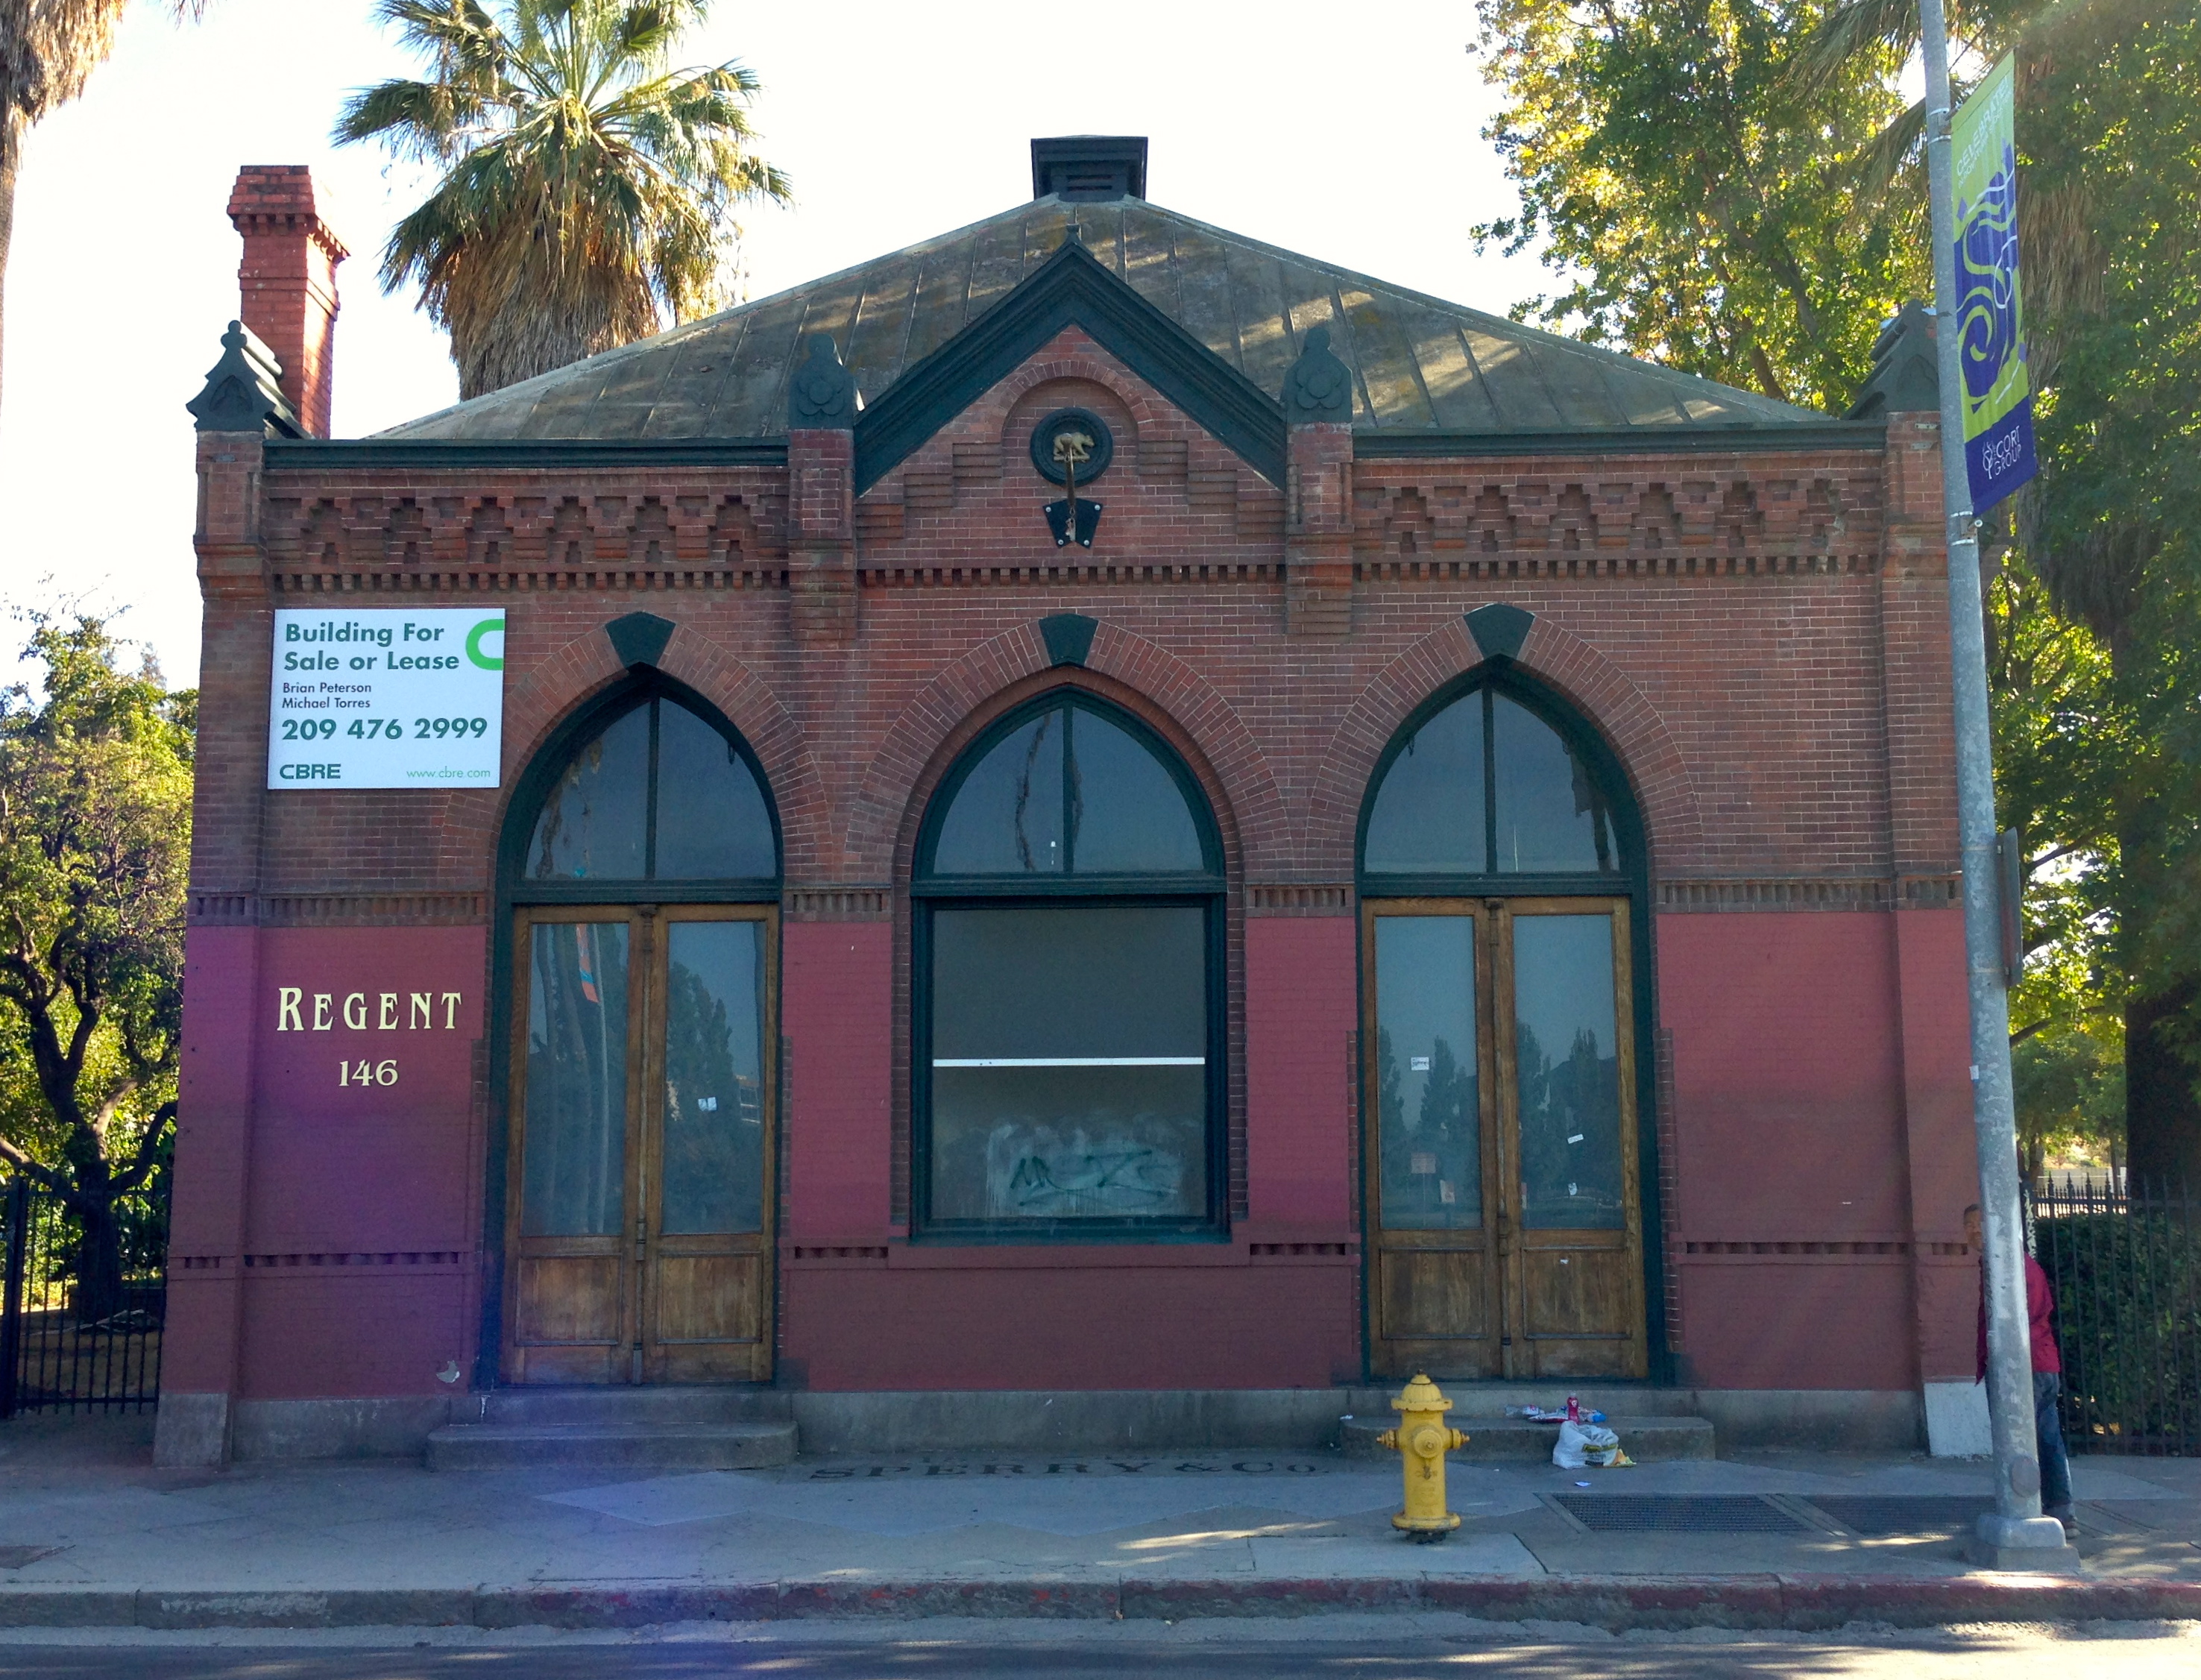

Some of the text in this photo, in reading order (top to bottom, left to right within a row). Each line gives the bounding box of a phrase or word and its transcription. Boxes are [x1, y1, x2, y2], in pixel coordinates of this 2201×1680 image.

[1996, 425, 2020, 458] CORT
[1994, 444, 2021, 476] GROUP
[286, 622, 444, 647] Building For
[284, 650, 459, 671] Sale or Lease
[283, 682, 372, 693] Brian Peterson
[282, 696, 371, 708] Michael Torres
[282, 717, 488, 740] 209 476 2999
[280, 764, 491, 779] CBRE www.cbre.com
[277, 987, 462, 1031] REGENT
[338, 1059, 400, 1086] 146
[810, 1462, 1156, 1479] SPERRY
